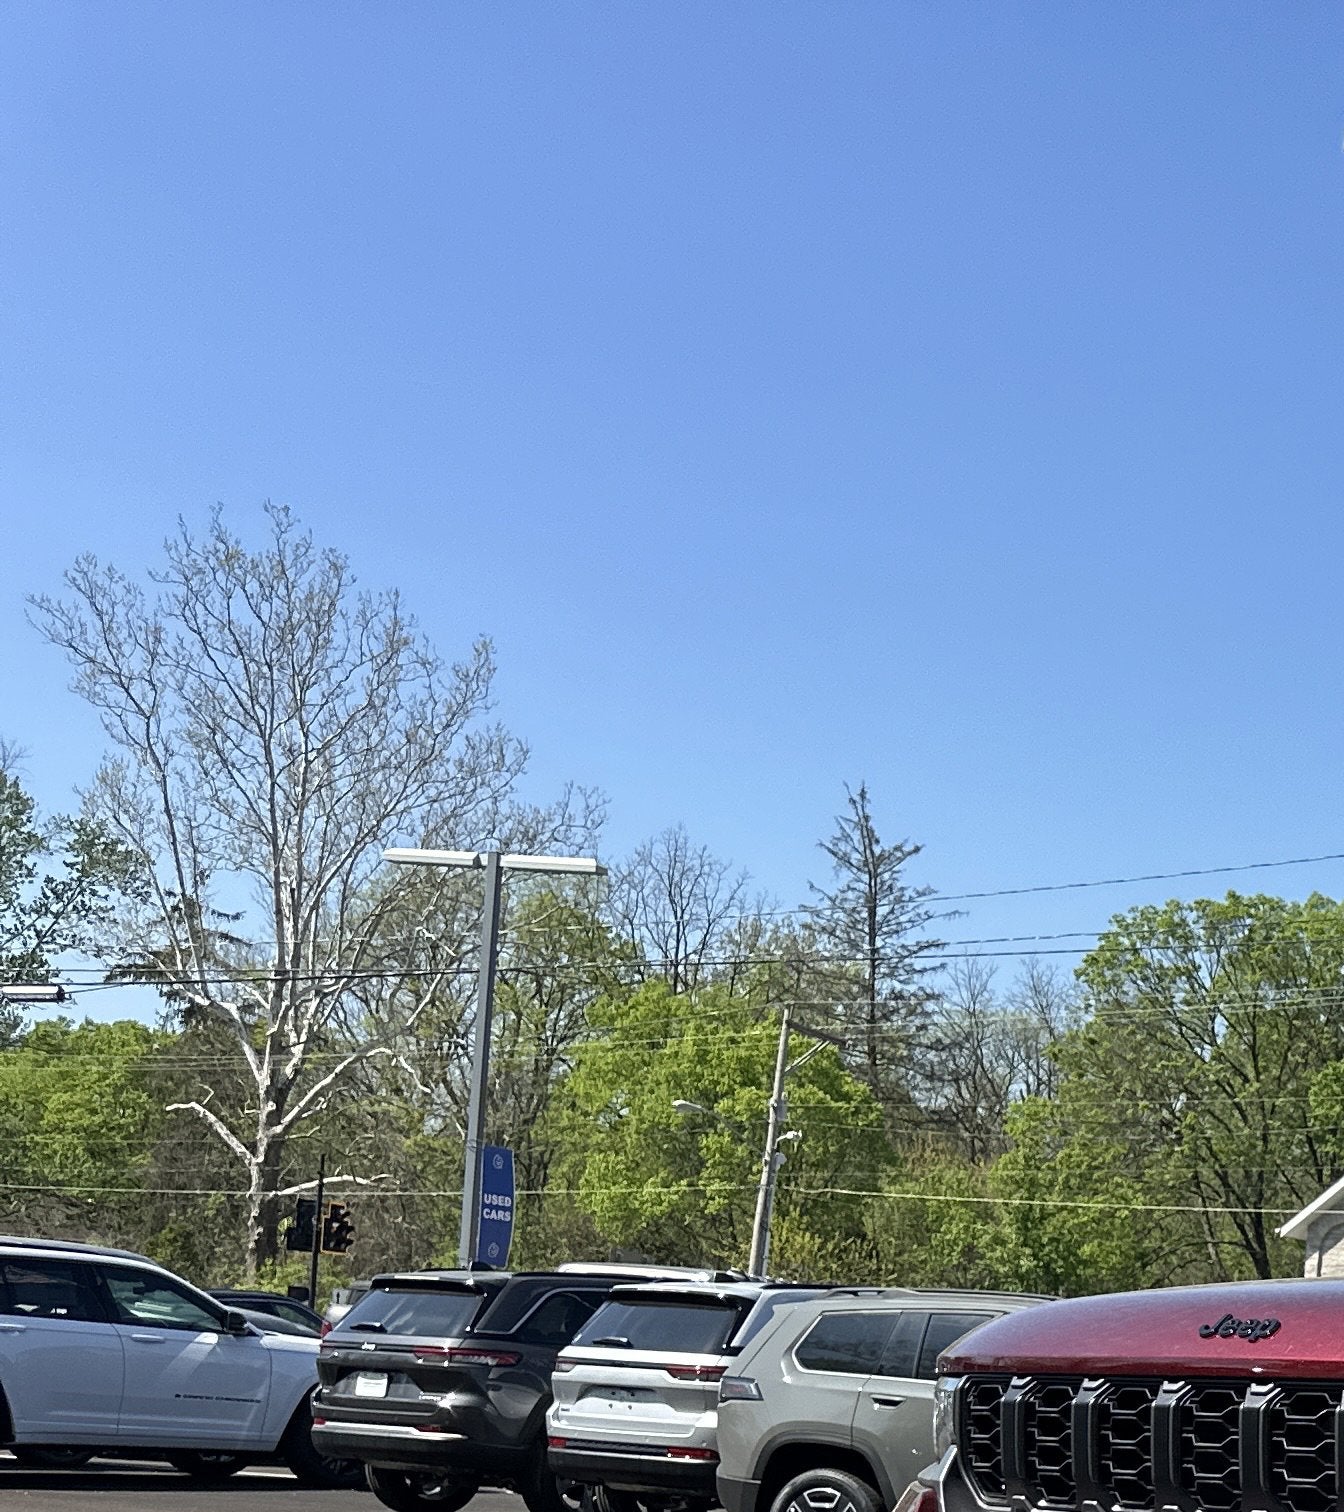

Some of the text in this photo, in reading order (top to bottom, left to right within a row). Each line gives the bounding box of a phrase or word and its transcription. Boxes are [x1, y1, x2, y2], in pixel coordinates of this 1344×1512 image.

[484, 1194, 512, 1207] USED
[483, 1208, 511, 1222] CARS
[1199, 1313, 1281, 1343] Jeep
